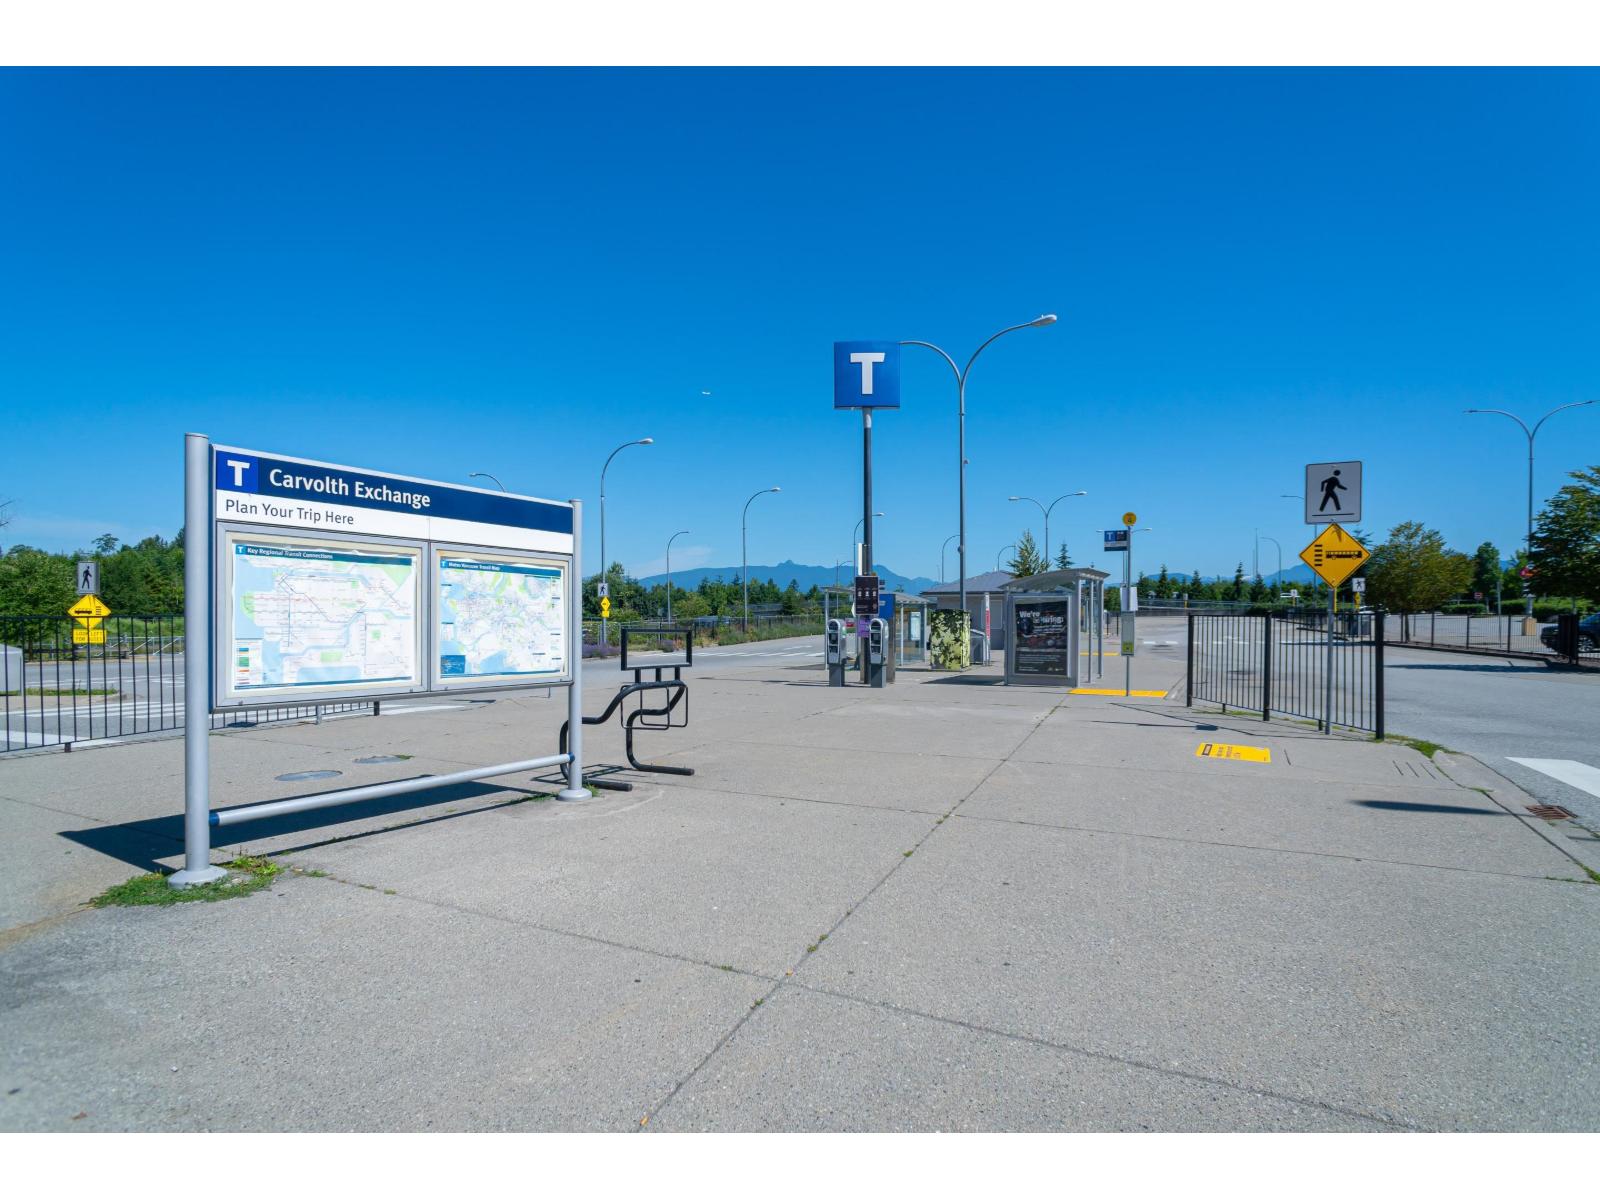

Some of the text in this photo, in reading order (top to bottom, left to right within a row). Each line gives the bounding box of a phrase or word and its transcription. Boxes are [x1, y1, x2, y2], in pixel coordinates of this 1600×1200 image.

[850, 352, 885, 395] T
[227, 460, 250, 487] T
[269, 468, 431, 510] Carvolth Exchange
[225, 499, 354, 525] Plan Your Trip Here
[247, 547, 259, 555] Key
[259, 548, 284, 557] Regional
[302, 551, 334, 560] Connections
